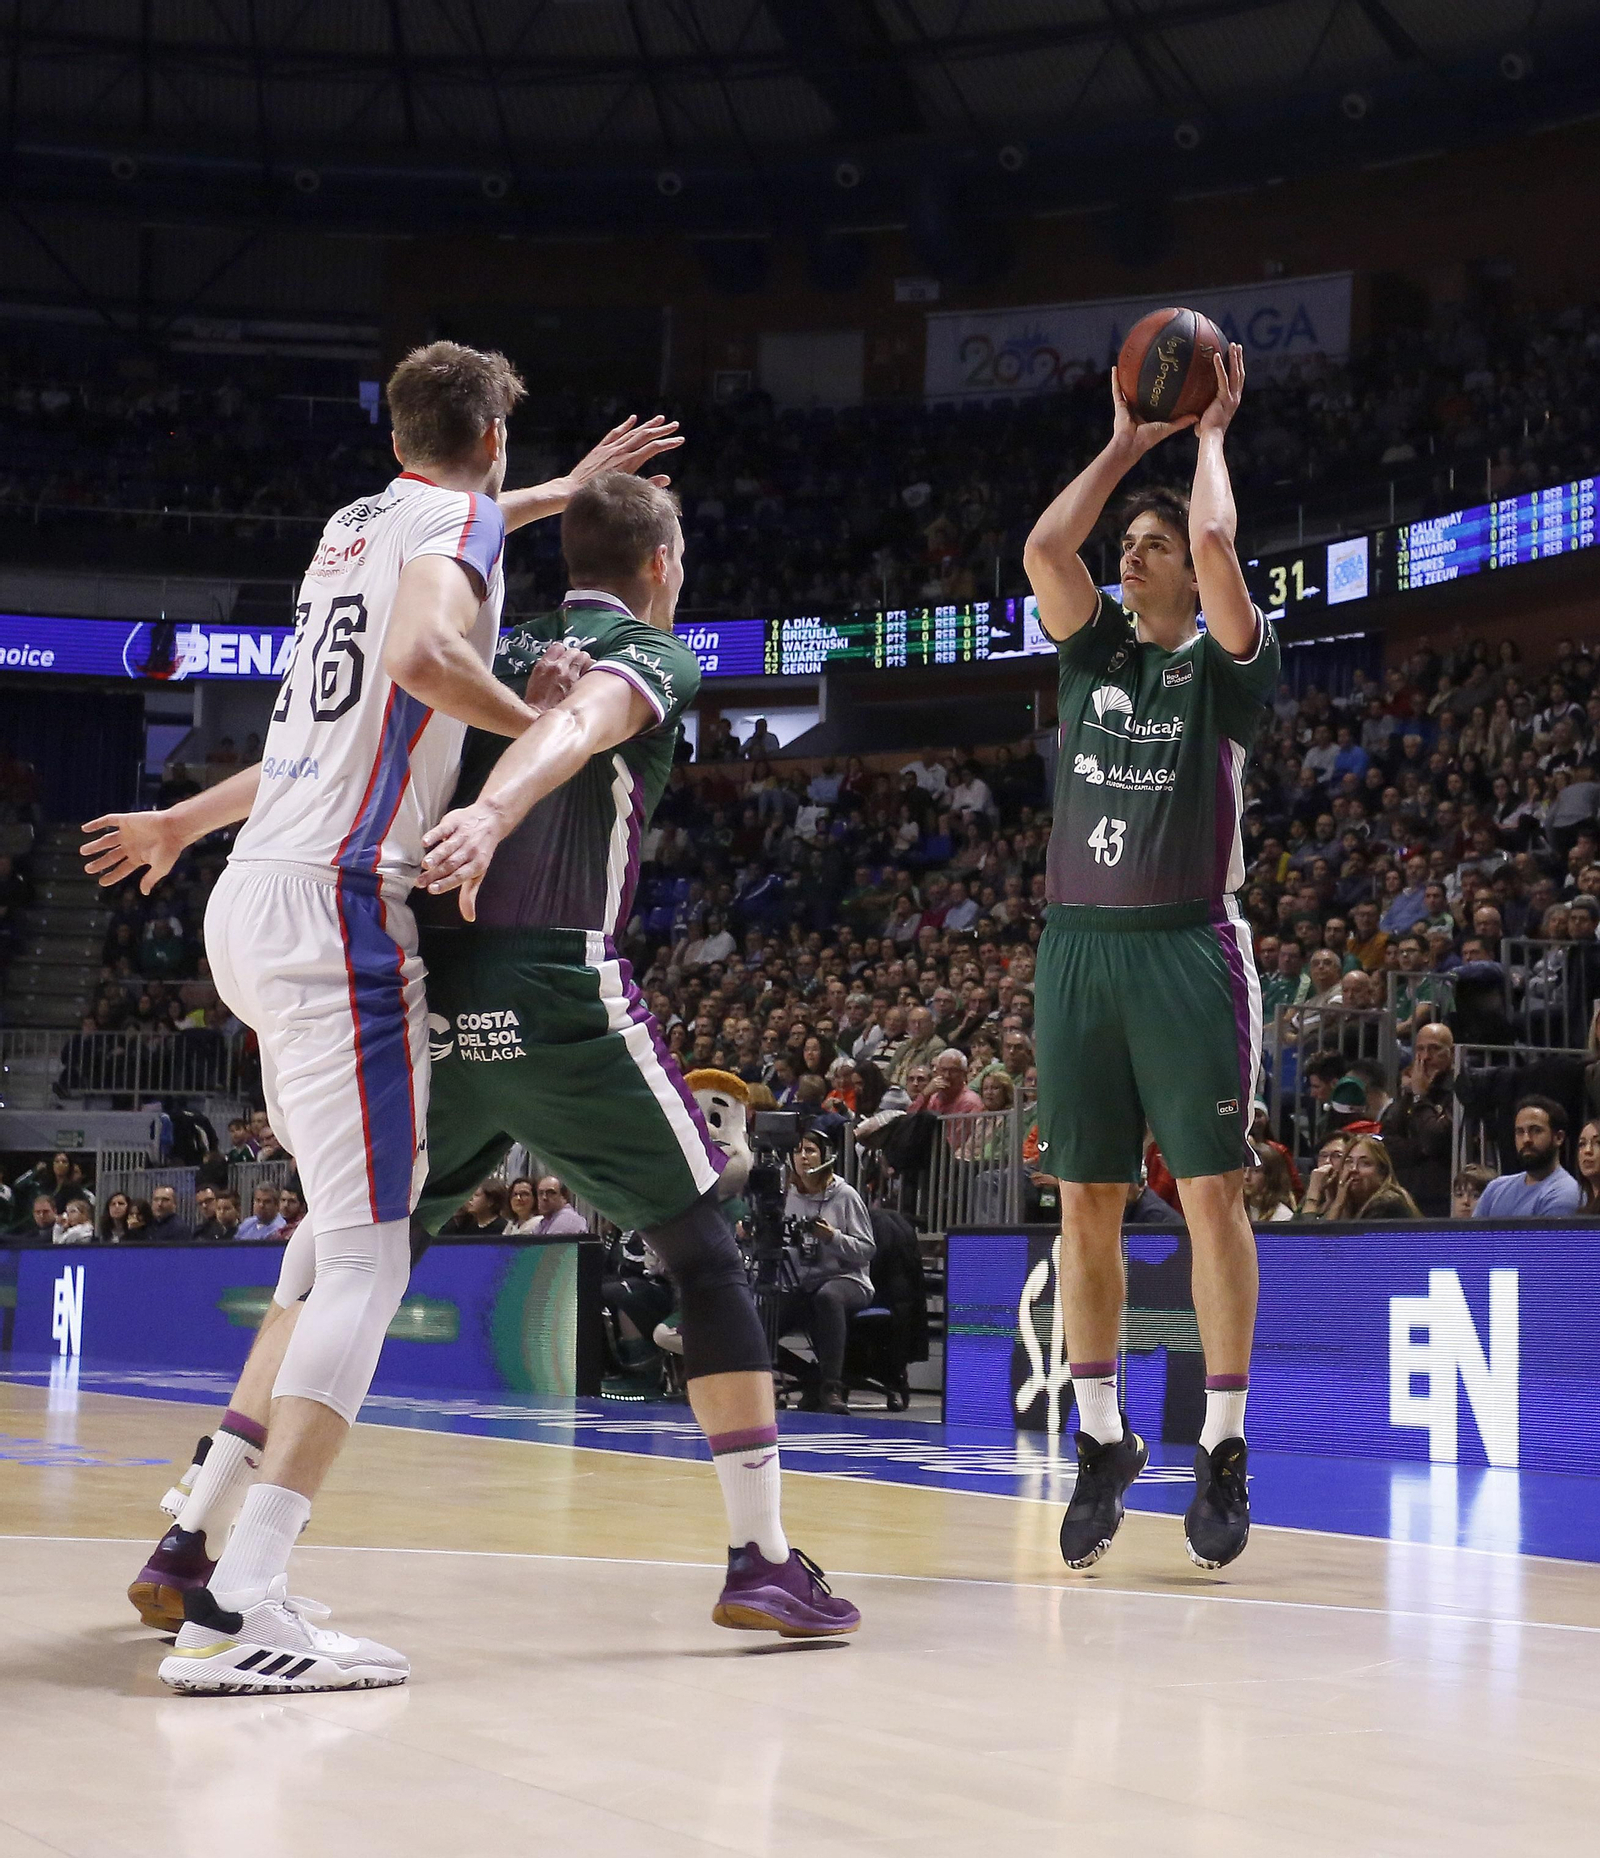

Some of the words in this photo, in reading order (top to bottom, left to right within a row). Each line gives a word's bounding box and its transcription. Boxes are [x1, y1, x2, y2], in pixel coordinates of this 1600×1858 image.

[1410, 511, 1463, 535] CALLOWAY
[1499, 498, 1518, 513] PTS
[1580, 479, 1594, 491] FP
[1499, 512, 1518, 527] PTS
[1580, 492, 1594, 505] FP
[1410, 539, 1457, 561] NAVARRO
[1499, 524, 1518, 539] PTS
[1581, 506, 1594, 519] FP
[1410, 556, 1444, 575] SPIRES
[1499, 537, 1518, 553] PTS
[1581, 519, 1594, 532] FP
[1410, 574, 1423, 588] DE
[1425, 566, 1459, 585] ZEEUW
[1499, 551, 1518, 567] PTS
[1581, 533, 1594, 547] FP
[1268, 559, 1304, 606] 31
[875, 612, 882, 623] 3
[887, 610, 906, 622] PTS
[922, 608, 929, 619] 2
[935, 605, 956, 617] REB
[976, 602, 989, 613] FP
[765, 641, 777, 652] 21
[875, 636, 882, 646] 3
[886, 634, 906, 644] PTS
[922, 632, 929, 642] 0
[935, 629, 956, 640] REB
[976, 625, 989, 636] FP
[782, 627, 838, 641] BRIZUELA
[875, 625, 882, 635] 3
[887, 622, 906, 633] PTS
[922, 620, 929, 630] 0
[935, 617, 956, 629] REB
[976, 614, 989, 625] FP
[875, 647, 882, 657] 0
[886, 645, 906, 656] PTS
[923, 643, 928, 653] 1
[935, 640, 956, 652] REB
[976, 637, 989, 647] FP
[765, 663, 778, 674] 52
[782, 662, 821, 674] GERUN
[875, 659, 882, 668] 0
[886, 656, 906, 667] PTS
[923, 654, 928, 665] 1
[935, 651, 956, 663] REB
[976, 648, 989, 660] FP
[617, 643, 679, 712] Andalucí
[1124, 716, 1184, 738] Unicaja
[1106, 780, 1134, 791] EUROPEAN
[1107, 764, 1176, 784] MÁLAGA
[1087, 815, 1128, 867] 43
[456, 1010, 520, 1031] COSTA
[458, 1033, 487, 1047] DEL
[488, 1030, 522, 1046] SOL
[460, 1047, 527, 1062] MÁLAGA
[1220, 1105, 1234, 1114] acb
